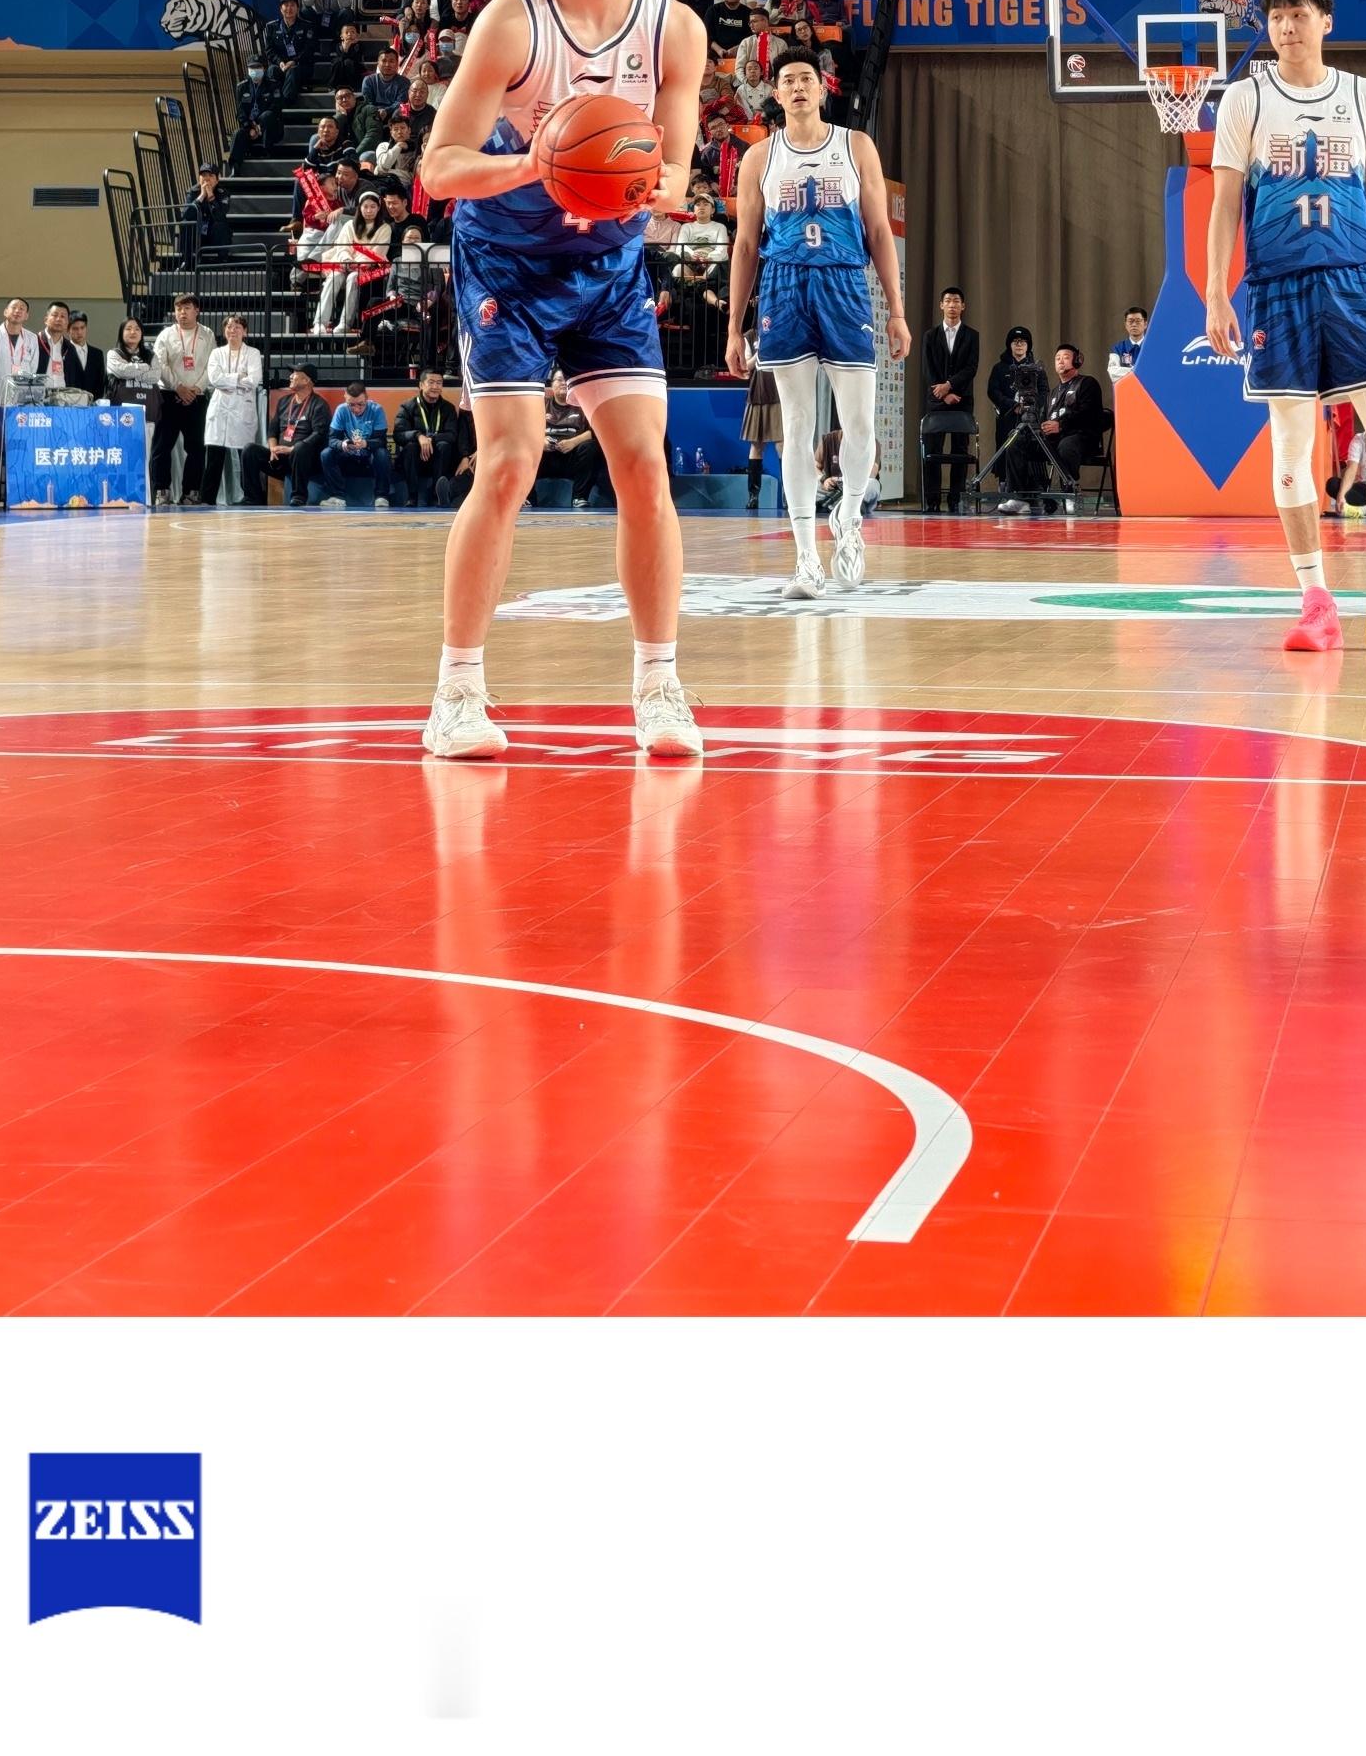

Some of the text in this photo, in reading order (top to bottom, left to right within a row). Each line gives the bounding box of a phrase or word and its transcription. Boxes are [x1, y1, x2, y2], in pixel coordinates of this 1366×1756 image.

[1267, 133, 1353, 180] 新疆
[779, 176, 843, 213] 新疆
[1294, 192, 1332, 228] 11
[804, 222, 822, 249] 9
[34, 447, 123, 466] 医疗救护席
[91, 735, 1065, 764] LI-NNG
